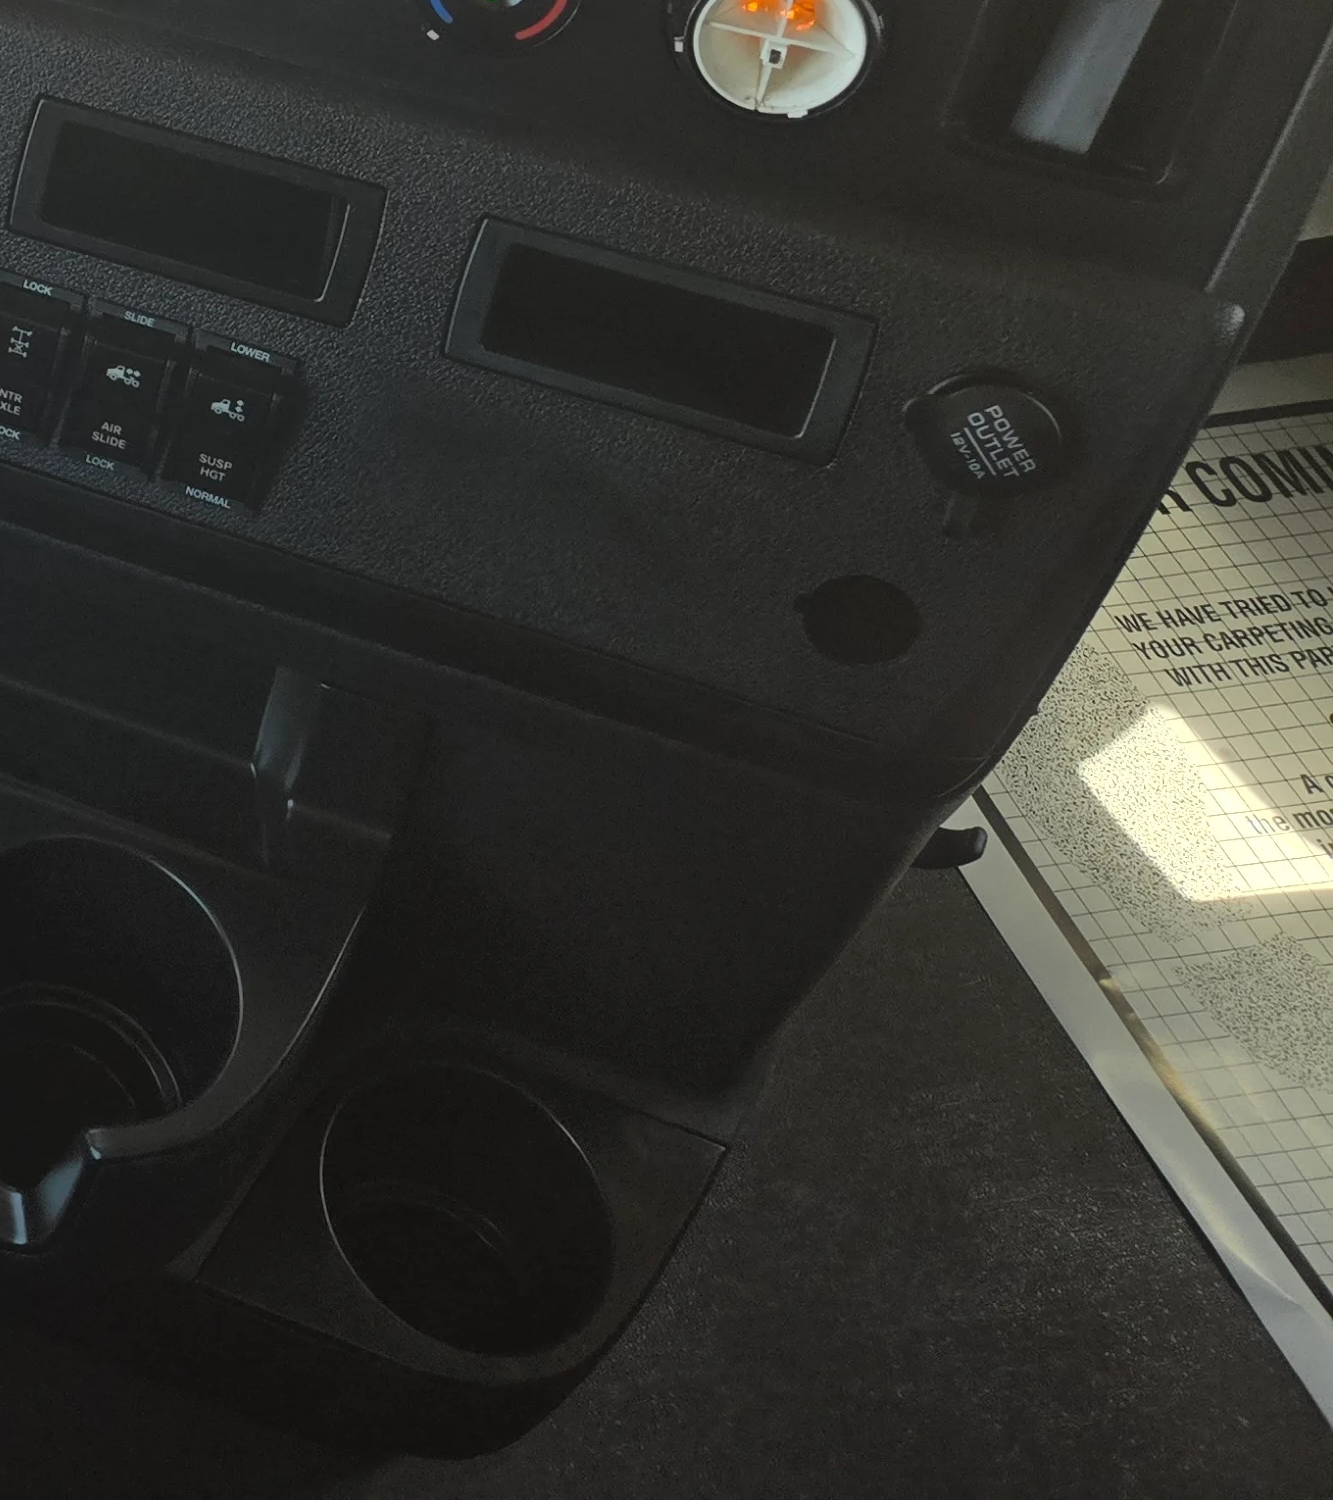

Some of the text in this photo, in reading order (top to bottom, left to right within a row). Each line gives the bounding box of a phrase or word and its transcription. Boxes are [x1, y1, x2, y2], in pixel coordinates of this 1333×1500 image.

[23, 279, 52, 296] LOCK
[124, 311, 155, 327] SLIDE
[231, 342, 271, 362] LOWER
[101, 421, 122, 435] AIR
[92, 431, 126, 450] SLIDE
[967, 412, 1020, 477] OUTLET
[984, 405, 1036, 472] POWER
[85, 454, 115, 471] LOCK
[199, 453, 233, 470] SUSP
[951, 432, 985, 479] 12V-10A
[200, 467, 226, 482] HGT
[185, 486, 231, 509] NORMAL
[1114, 588, 1325, 633] WE HAVE TRIED TO
[1132, 616, 1333, 661] YOUR CARPETING
[1164, 654, 1290, 687] WITH THIS
[1299, 773, 1325, 794] A
[1245, 814, 1291, 834] the
